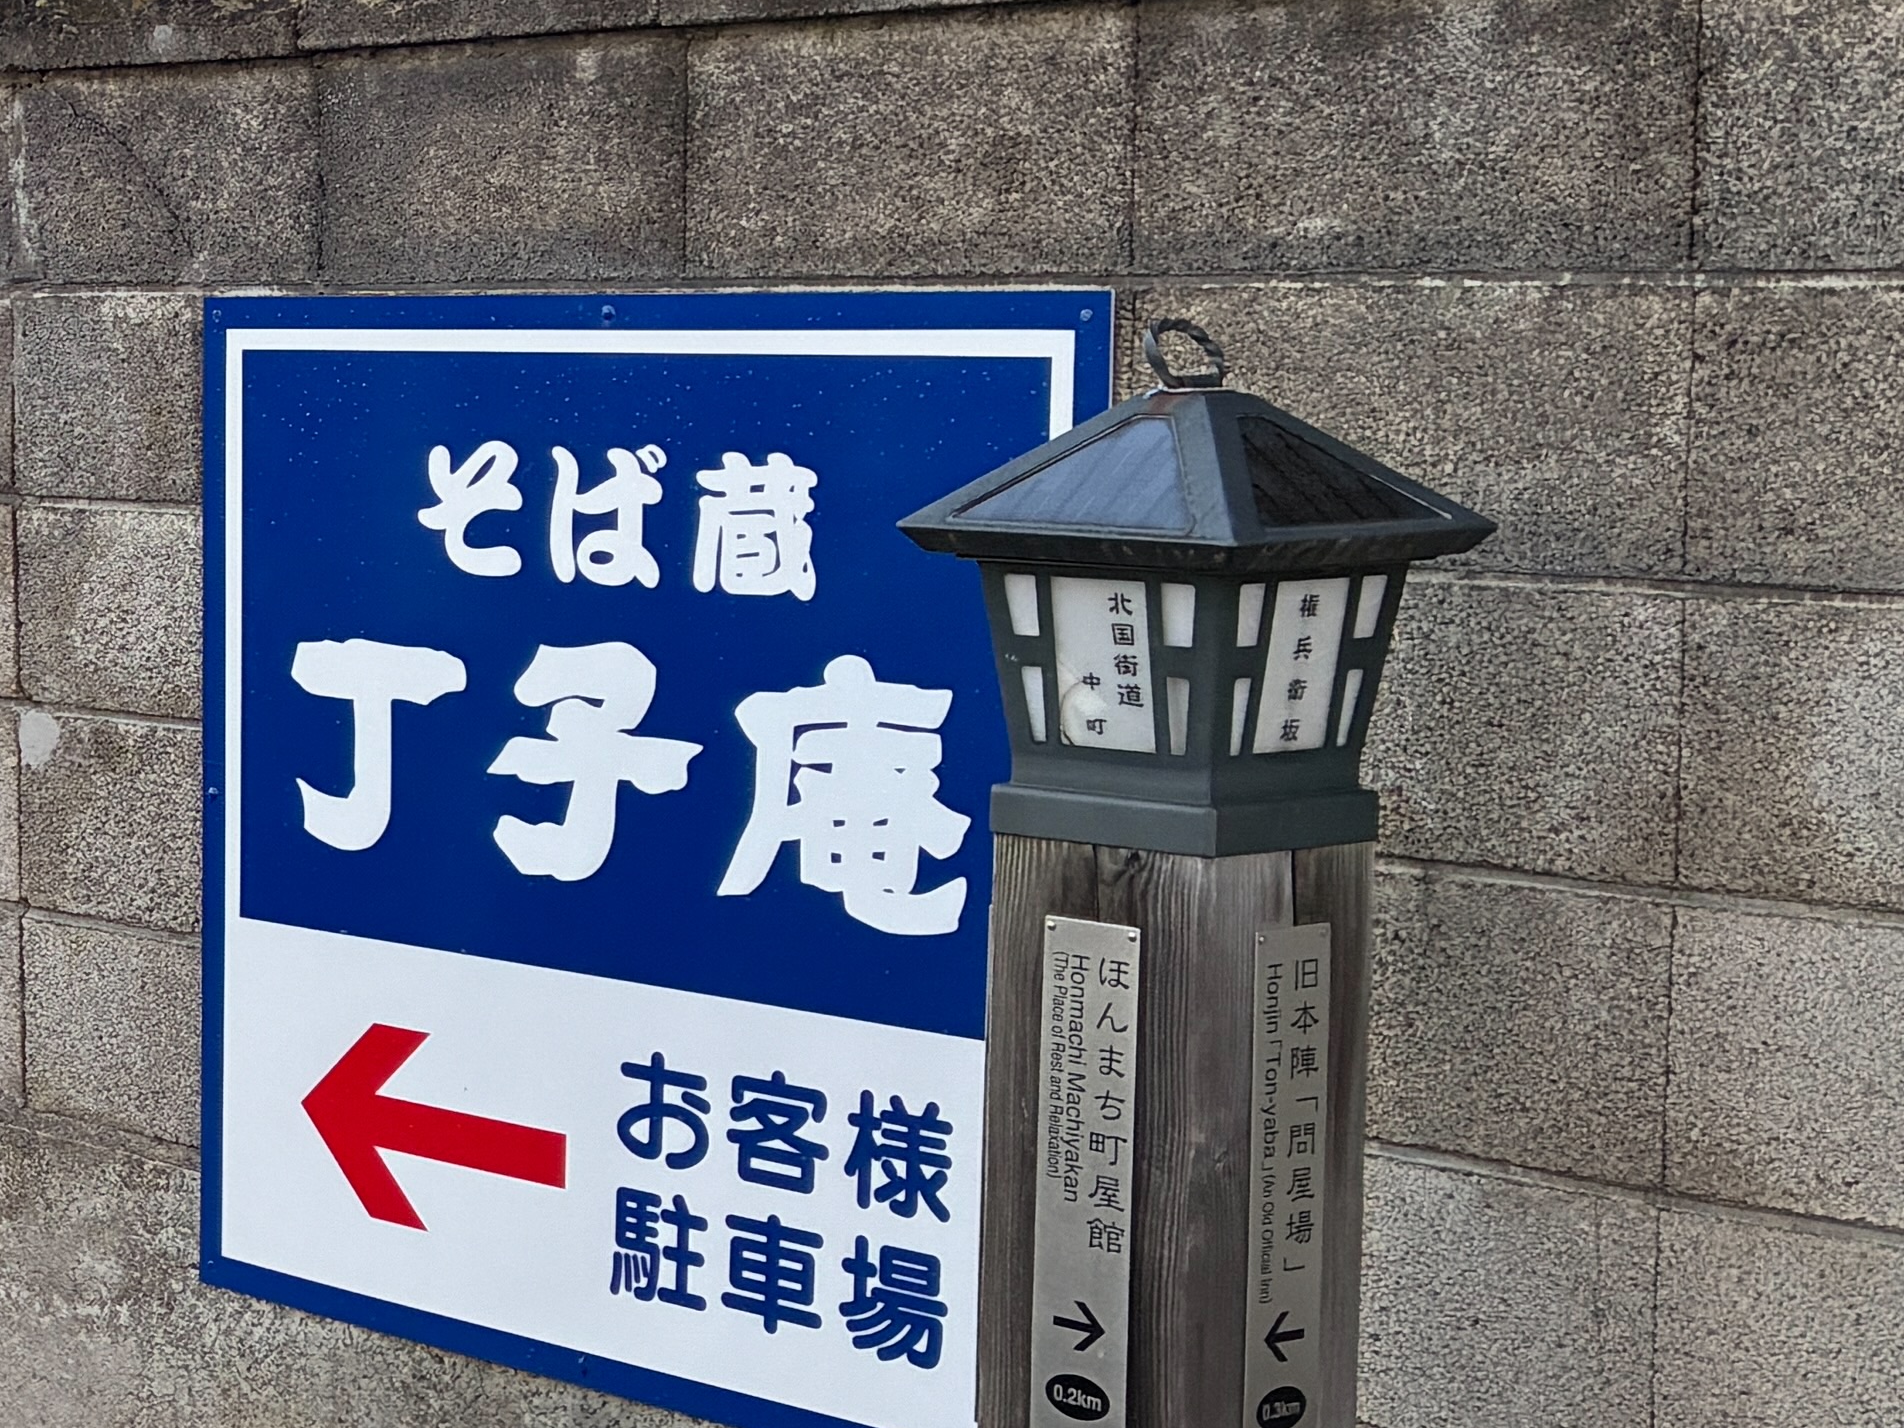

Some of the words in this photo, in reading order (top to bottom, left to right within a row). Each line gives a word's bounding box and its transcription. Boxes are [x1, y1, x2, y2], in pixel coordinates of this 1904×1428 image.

[417, 439, 819, 601] そば蔵
[1107, 592, 1144, 708] 北国街道
[1082, 672, 1107, 735] 中町
[290, 637, 973, 936] 丁子庵
[1052, 951, 1069, 981] (The
[1052, 985, 1068, 1022] Place
[1263, 963, 1283, 1034] Honjin
[1051, 1025, 1066, 1040] of
[1068, 954, 1091, 1066] Honmachi
[1049, 1075, 1064, 1101] and
[1051, 1042, 1066, 1073] Rest
[616, 1050, 954, 1223] お客様
[1046, 1104, 1064, 1180] Relaxation)
[1060, 1072, 1087, 1203] Machiyakan
[1086, 957, 1130, 1253] ほんまち町屋館
[1283, 958, 1319, 1271] 旧本陣「問屋場」
[609, 1186, 949, 1370] 駐車場
[1053, 1384, 1102, 1412] 0.2km
[1262, 1401, 1301, 1421] 0.3km
